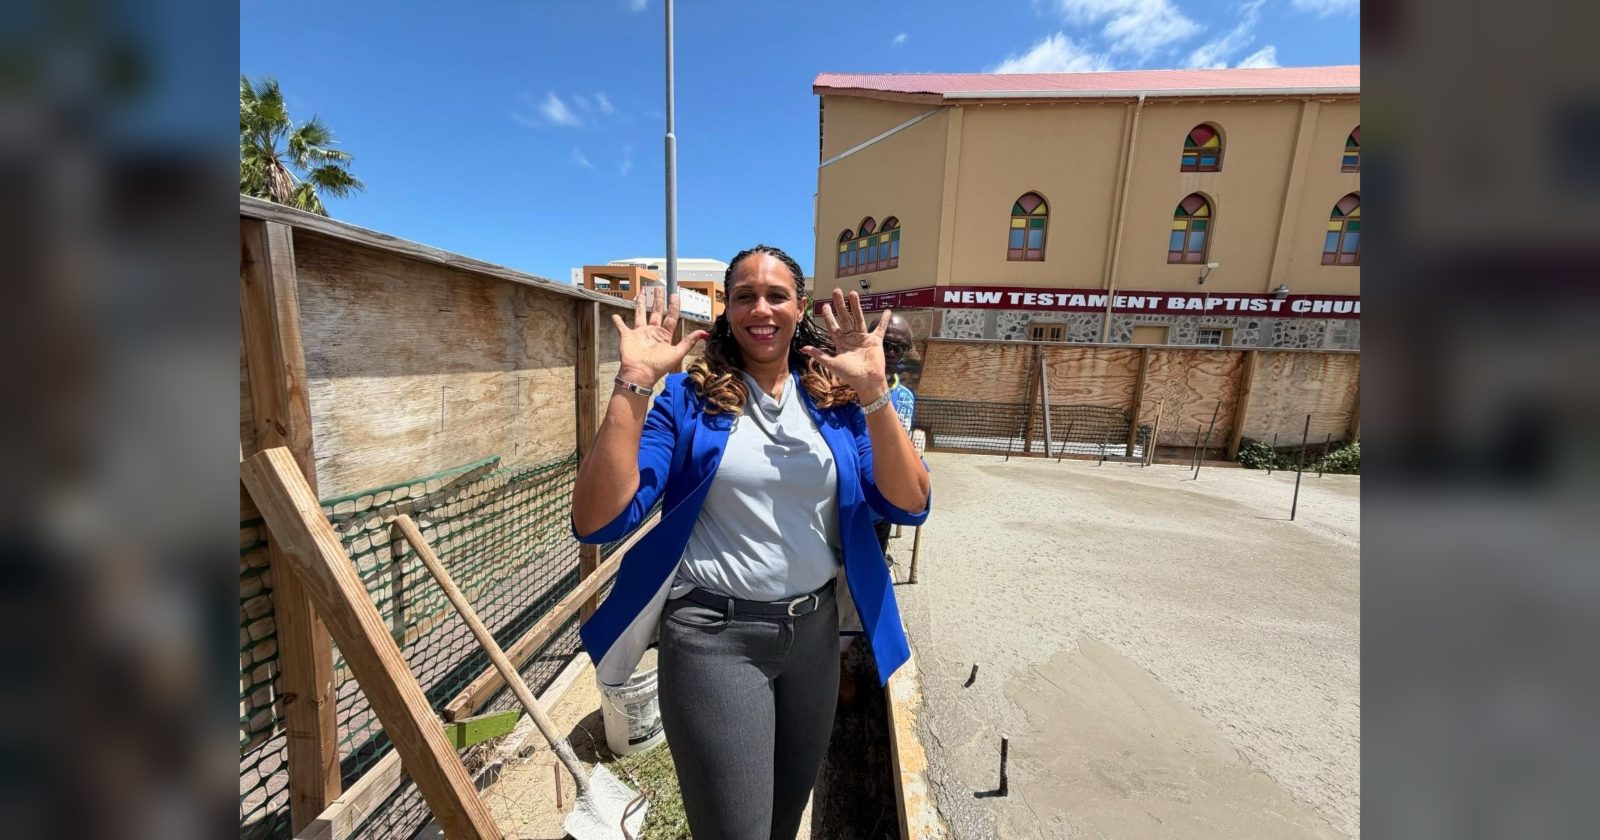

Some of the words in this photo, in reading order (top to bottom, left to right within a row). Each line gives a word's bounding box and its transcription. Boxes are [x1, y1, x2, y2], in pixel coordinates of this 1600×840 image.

[943, 290, 1003, 304] NEW
[1007, 292, 1163, 309] TESTAMENT
[1167, 297, 1287, 312] BAPTIST
